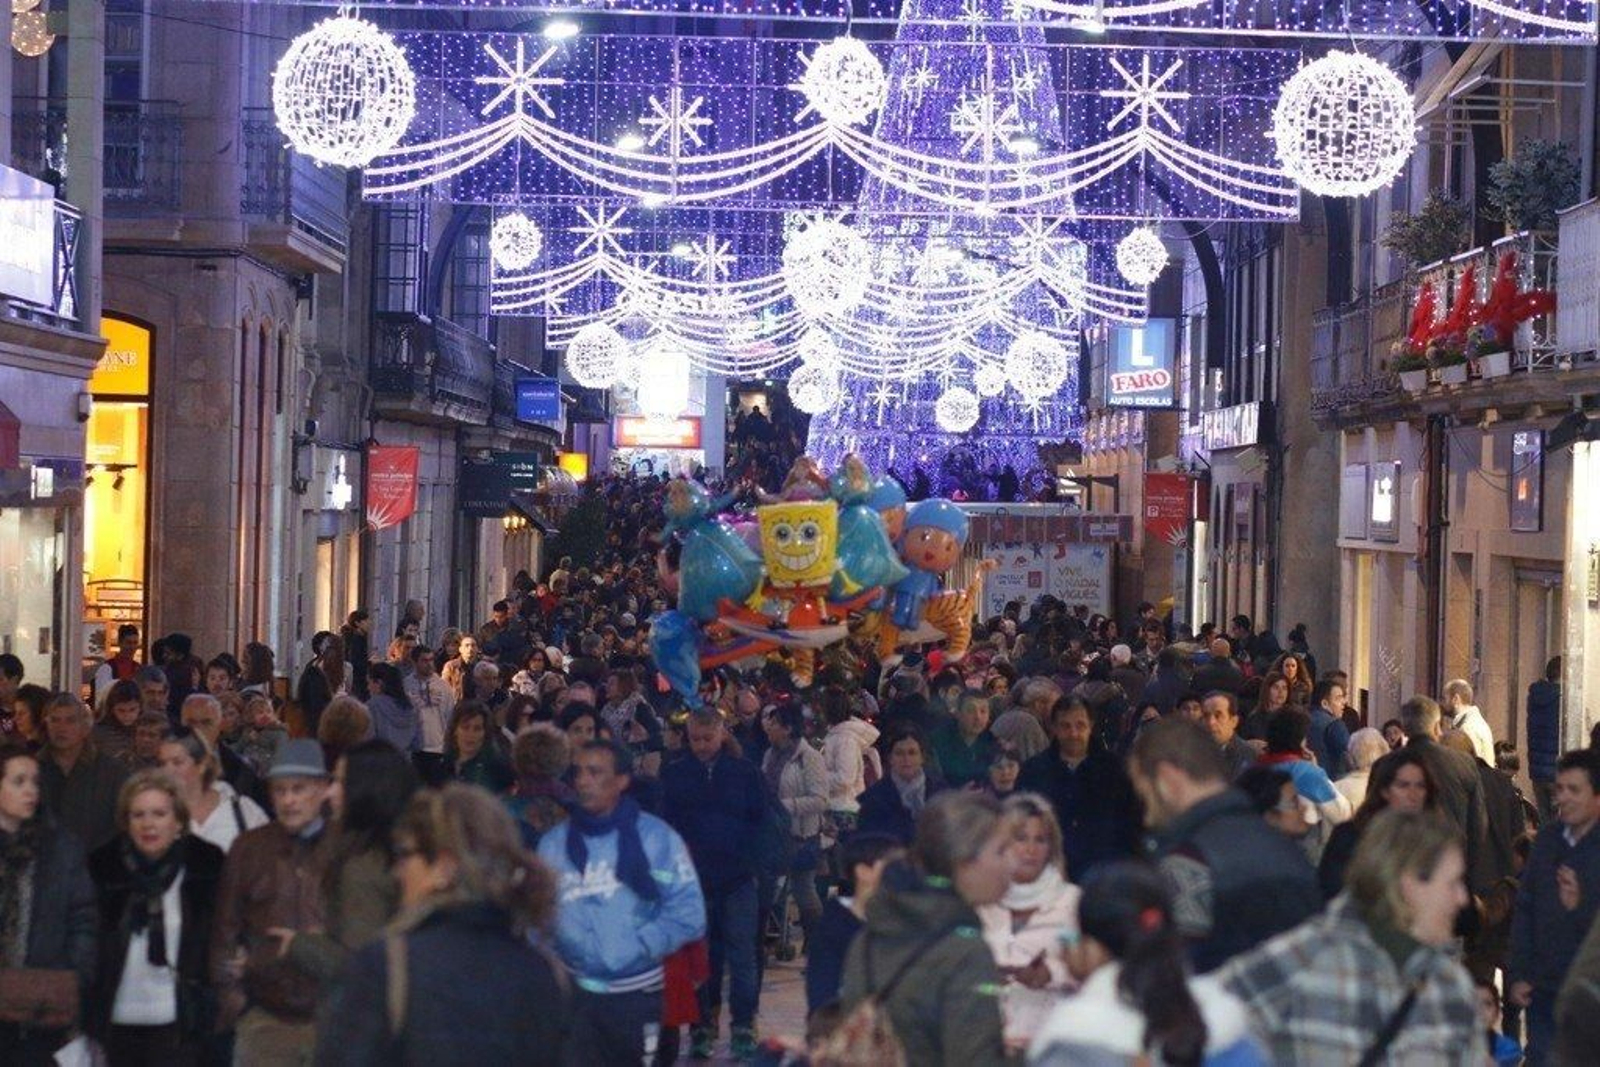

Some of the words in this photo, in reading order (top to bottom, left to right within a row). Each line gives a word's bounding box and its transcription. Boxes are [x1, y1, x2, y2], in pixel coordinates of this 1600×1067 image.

[1131, 328, 1154, 366] L
[1115, 371, 1168, 391] FARO
[1109, 396, 1134, 406] AUTO
[1135, 396, 1173, 407] ESCOLAS
